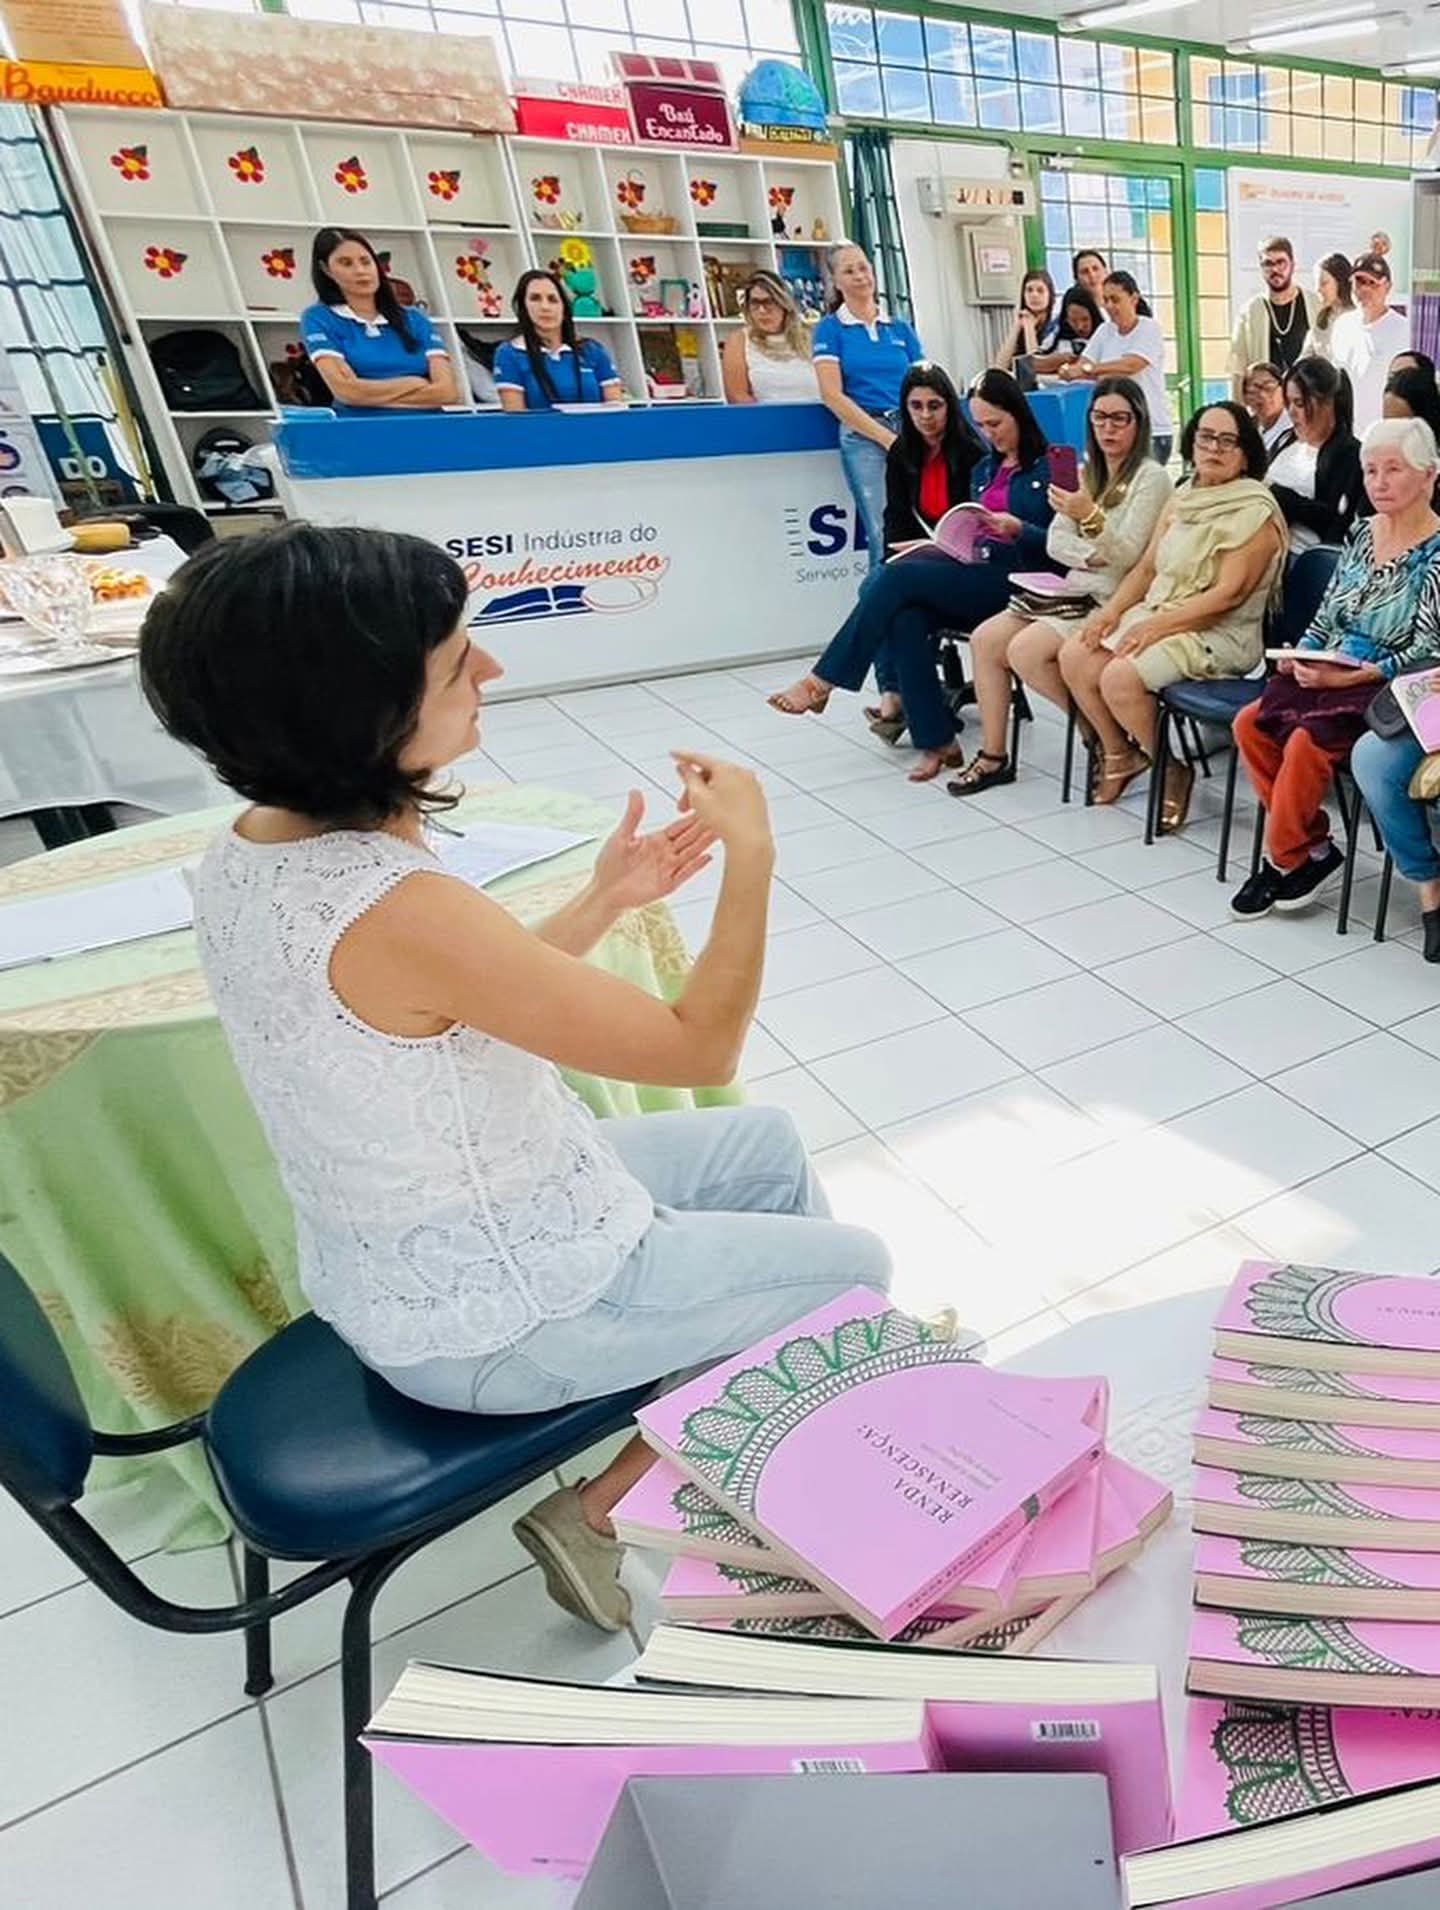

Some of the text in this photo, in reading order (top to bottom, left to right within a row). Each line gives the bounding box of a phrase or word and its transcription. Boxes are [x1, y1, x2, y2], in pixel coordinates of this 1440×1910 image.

[4, 63, 158, 107] Bauducco
[645, 118, 724, 143] Encantado
[659, 103, 696, 124] Baú
[446, 523, 658, 559] SESI Indústria do
[463, 551, 663, 594] Conhecimento
[795, 566, 849, 583] Serviço
[894, 1476, 954, 1525] RENDA
